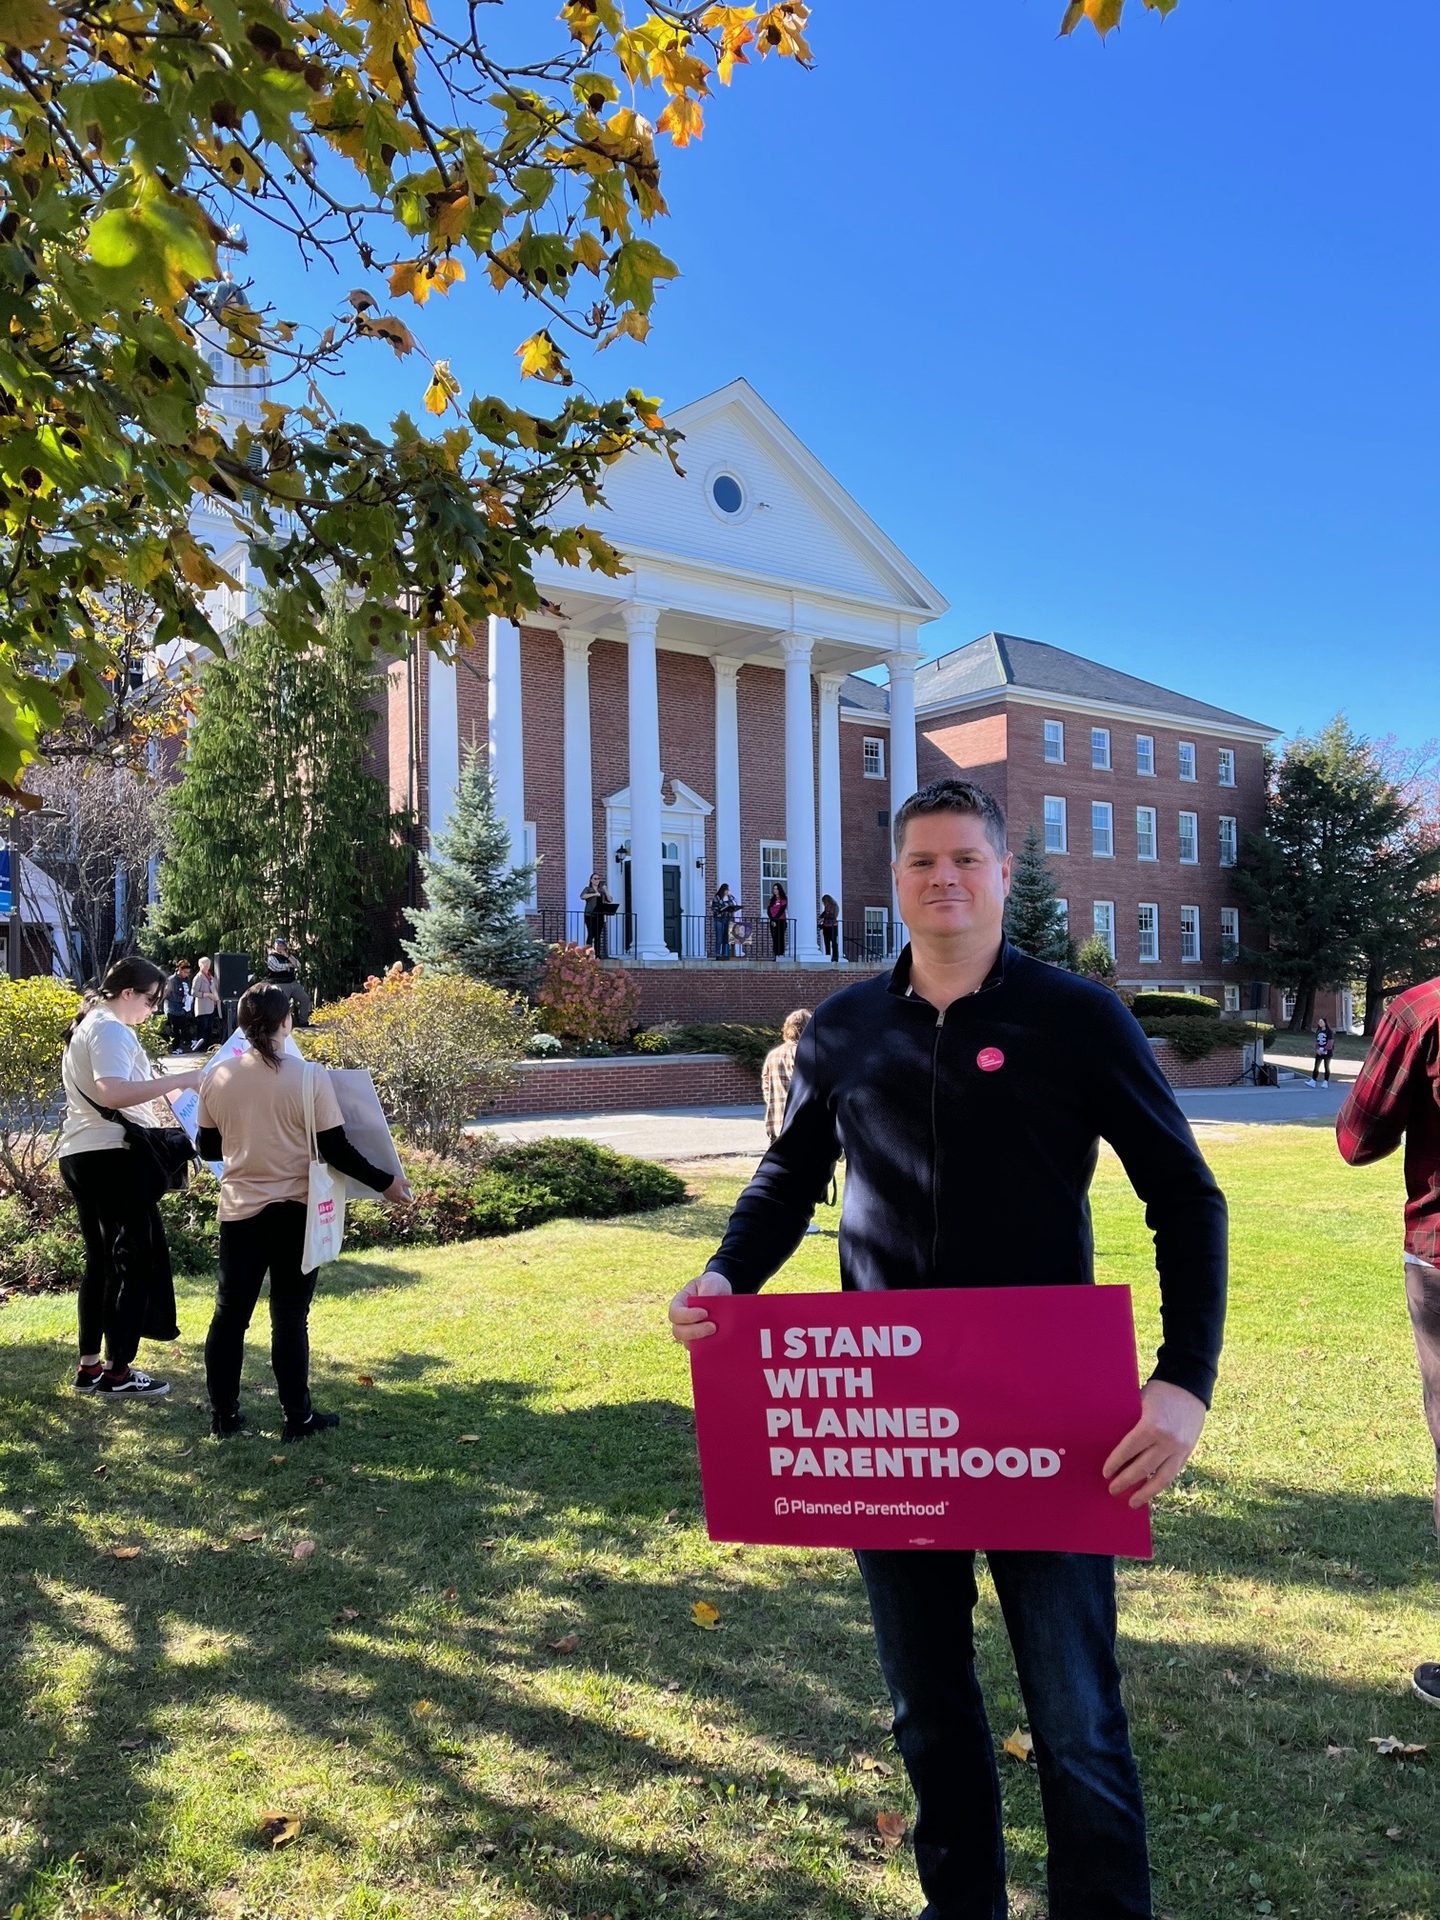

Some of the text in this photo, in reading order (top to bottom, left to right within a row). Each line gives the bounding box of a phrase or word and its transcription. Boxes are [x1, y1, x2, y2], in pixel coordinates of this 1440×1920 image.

[761, 1326, 922, 1359] I STAND
[763, 1367, 874, 1399] WITH
[766, 1407, 960, 1438] PLANNED
[791, 1499, 852, 1515] Planned
